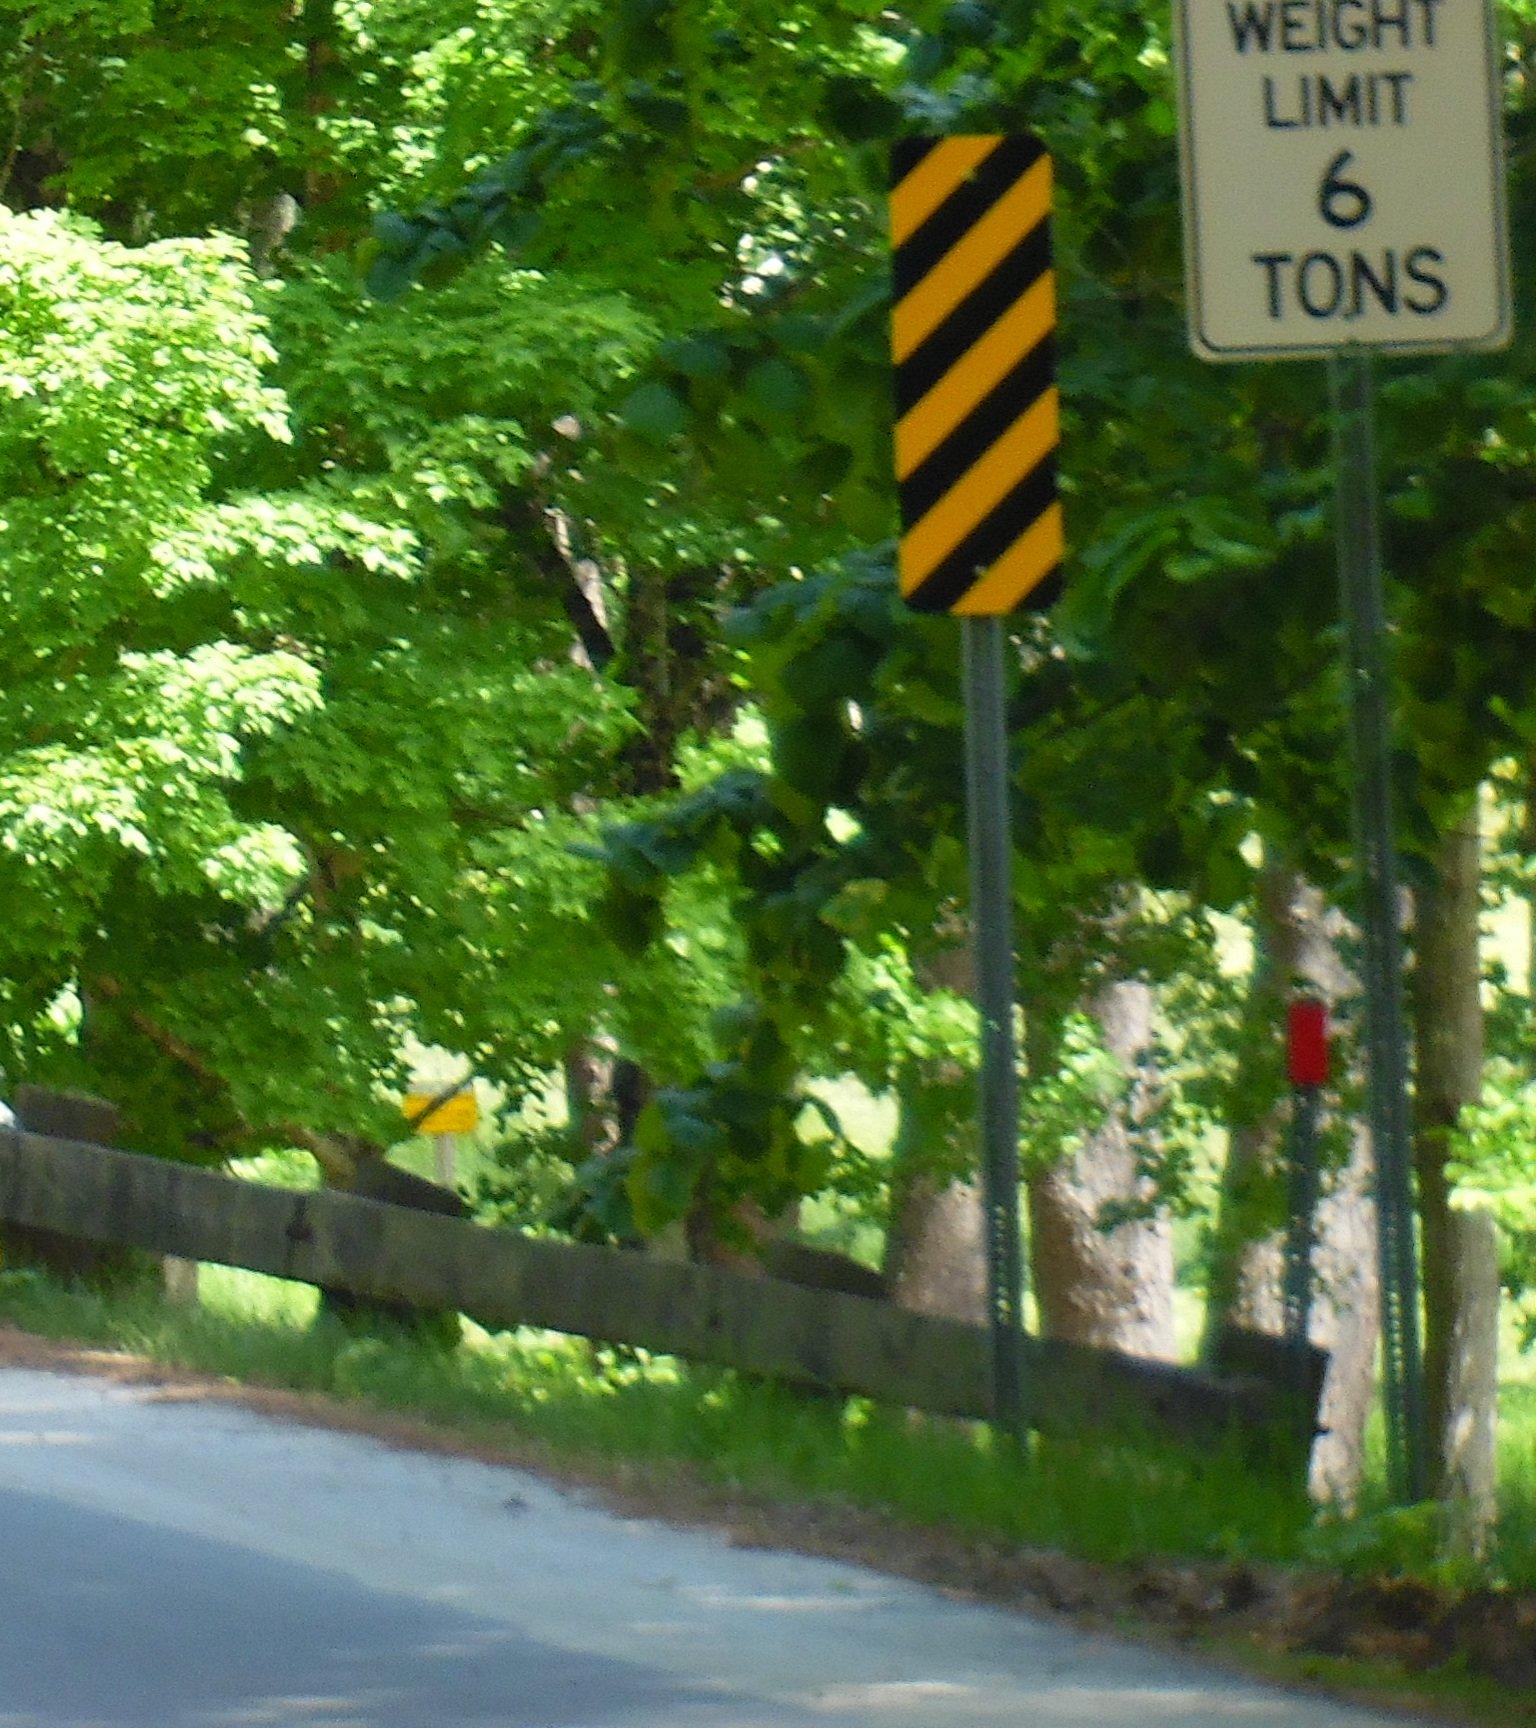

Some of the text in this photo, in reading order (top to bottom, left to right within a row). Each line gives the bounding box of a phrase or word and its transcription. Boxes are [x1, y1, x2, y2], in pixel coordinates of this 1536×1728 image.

[1262, 71, 1412, 130] LIMIT
[1318, 149, 1373, 229] 6
[1250, 246, 1449, 319] TONS
